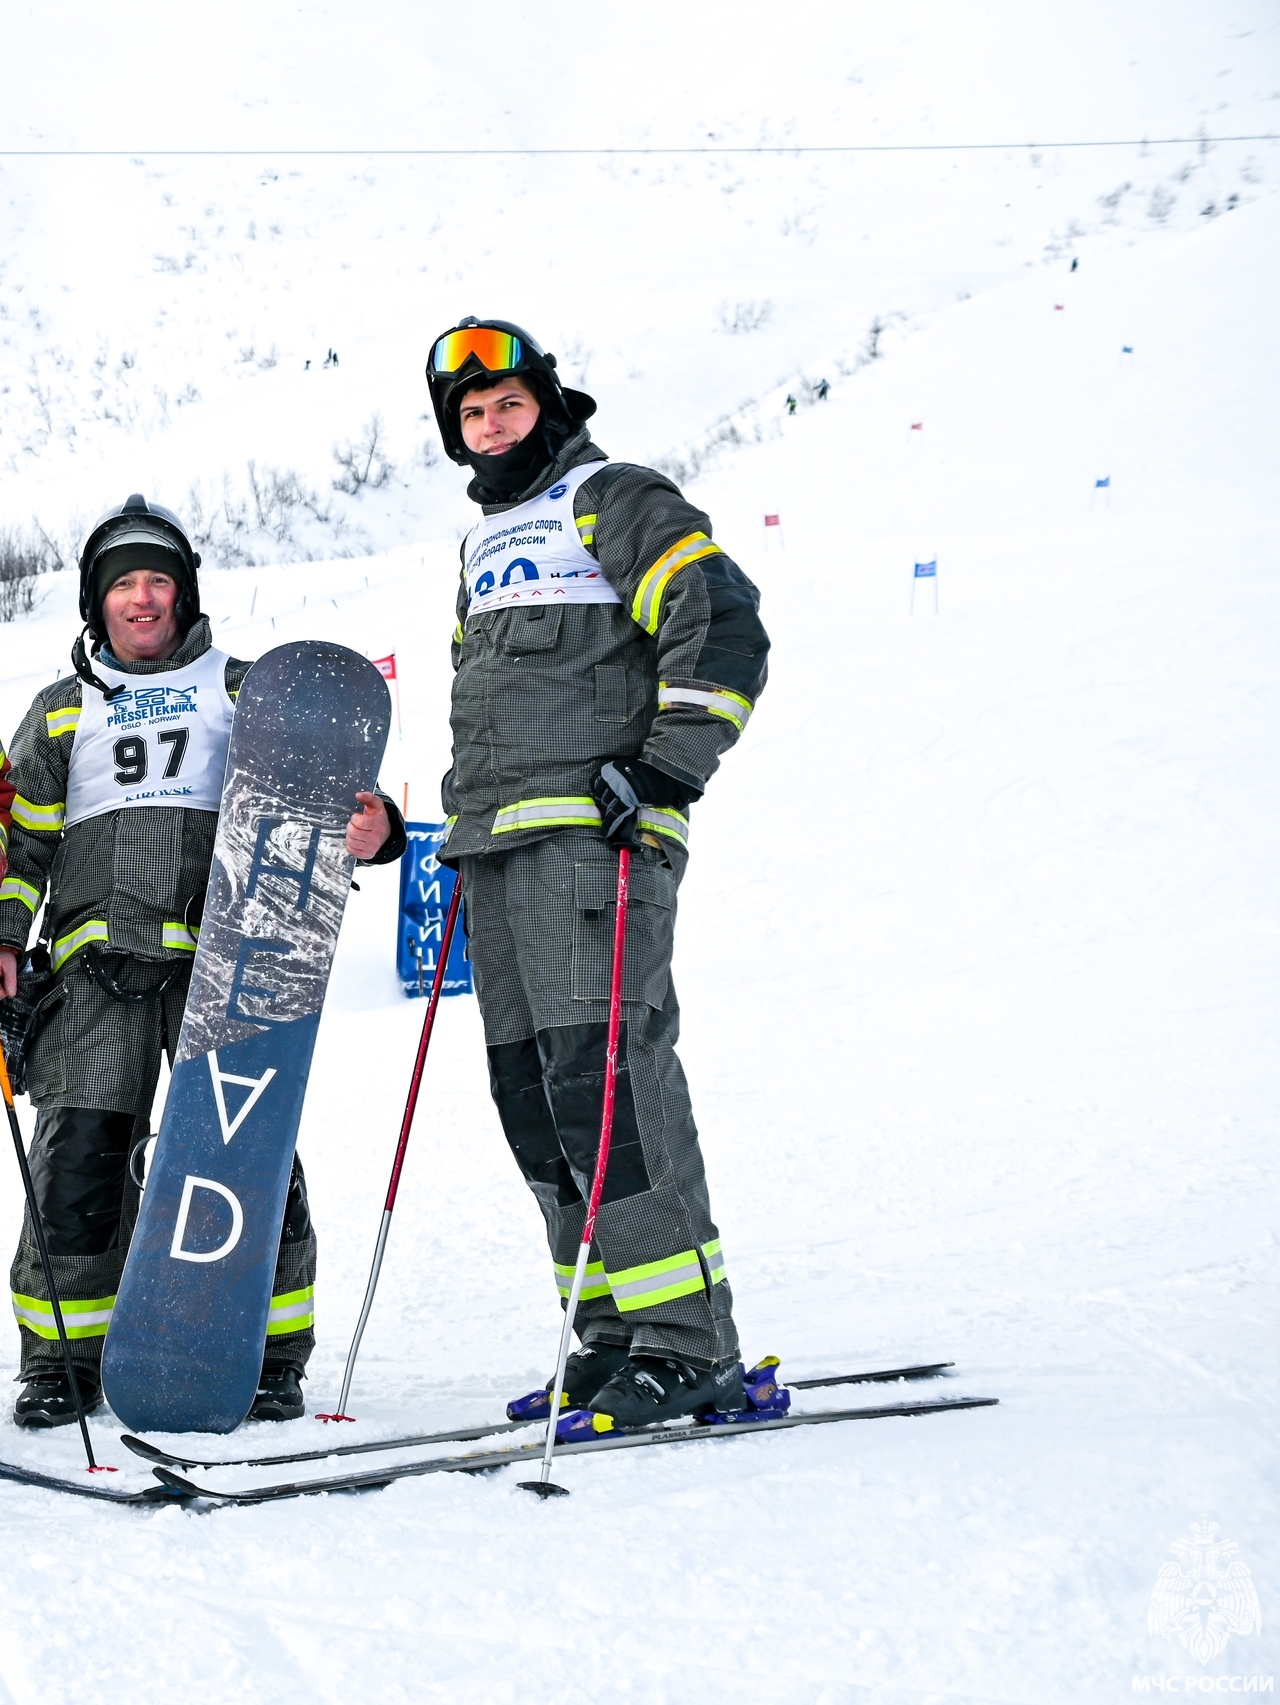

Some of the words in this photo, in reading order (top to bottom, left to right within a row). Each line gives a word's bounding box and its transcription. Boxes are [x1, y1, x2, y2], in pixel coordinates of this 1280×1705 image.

[534, 519, 563, 534] спорта
[508, 535, 546, 549] России
[107, 703, 198, 727] PRESSETEKNIKK
[121, 721, 142, 731] OSLO
[148, 714, 182, 726] NORWAY
[112, 727, 190, 787] 97
[125, 786, 194, 803] KIROVSK
[170, 818, 322, 1264] HEAD
[651, 1430, 688, 1441] PLASMA
[689, 1427, 712, 1436] EDGE
